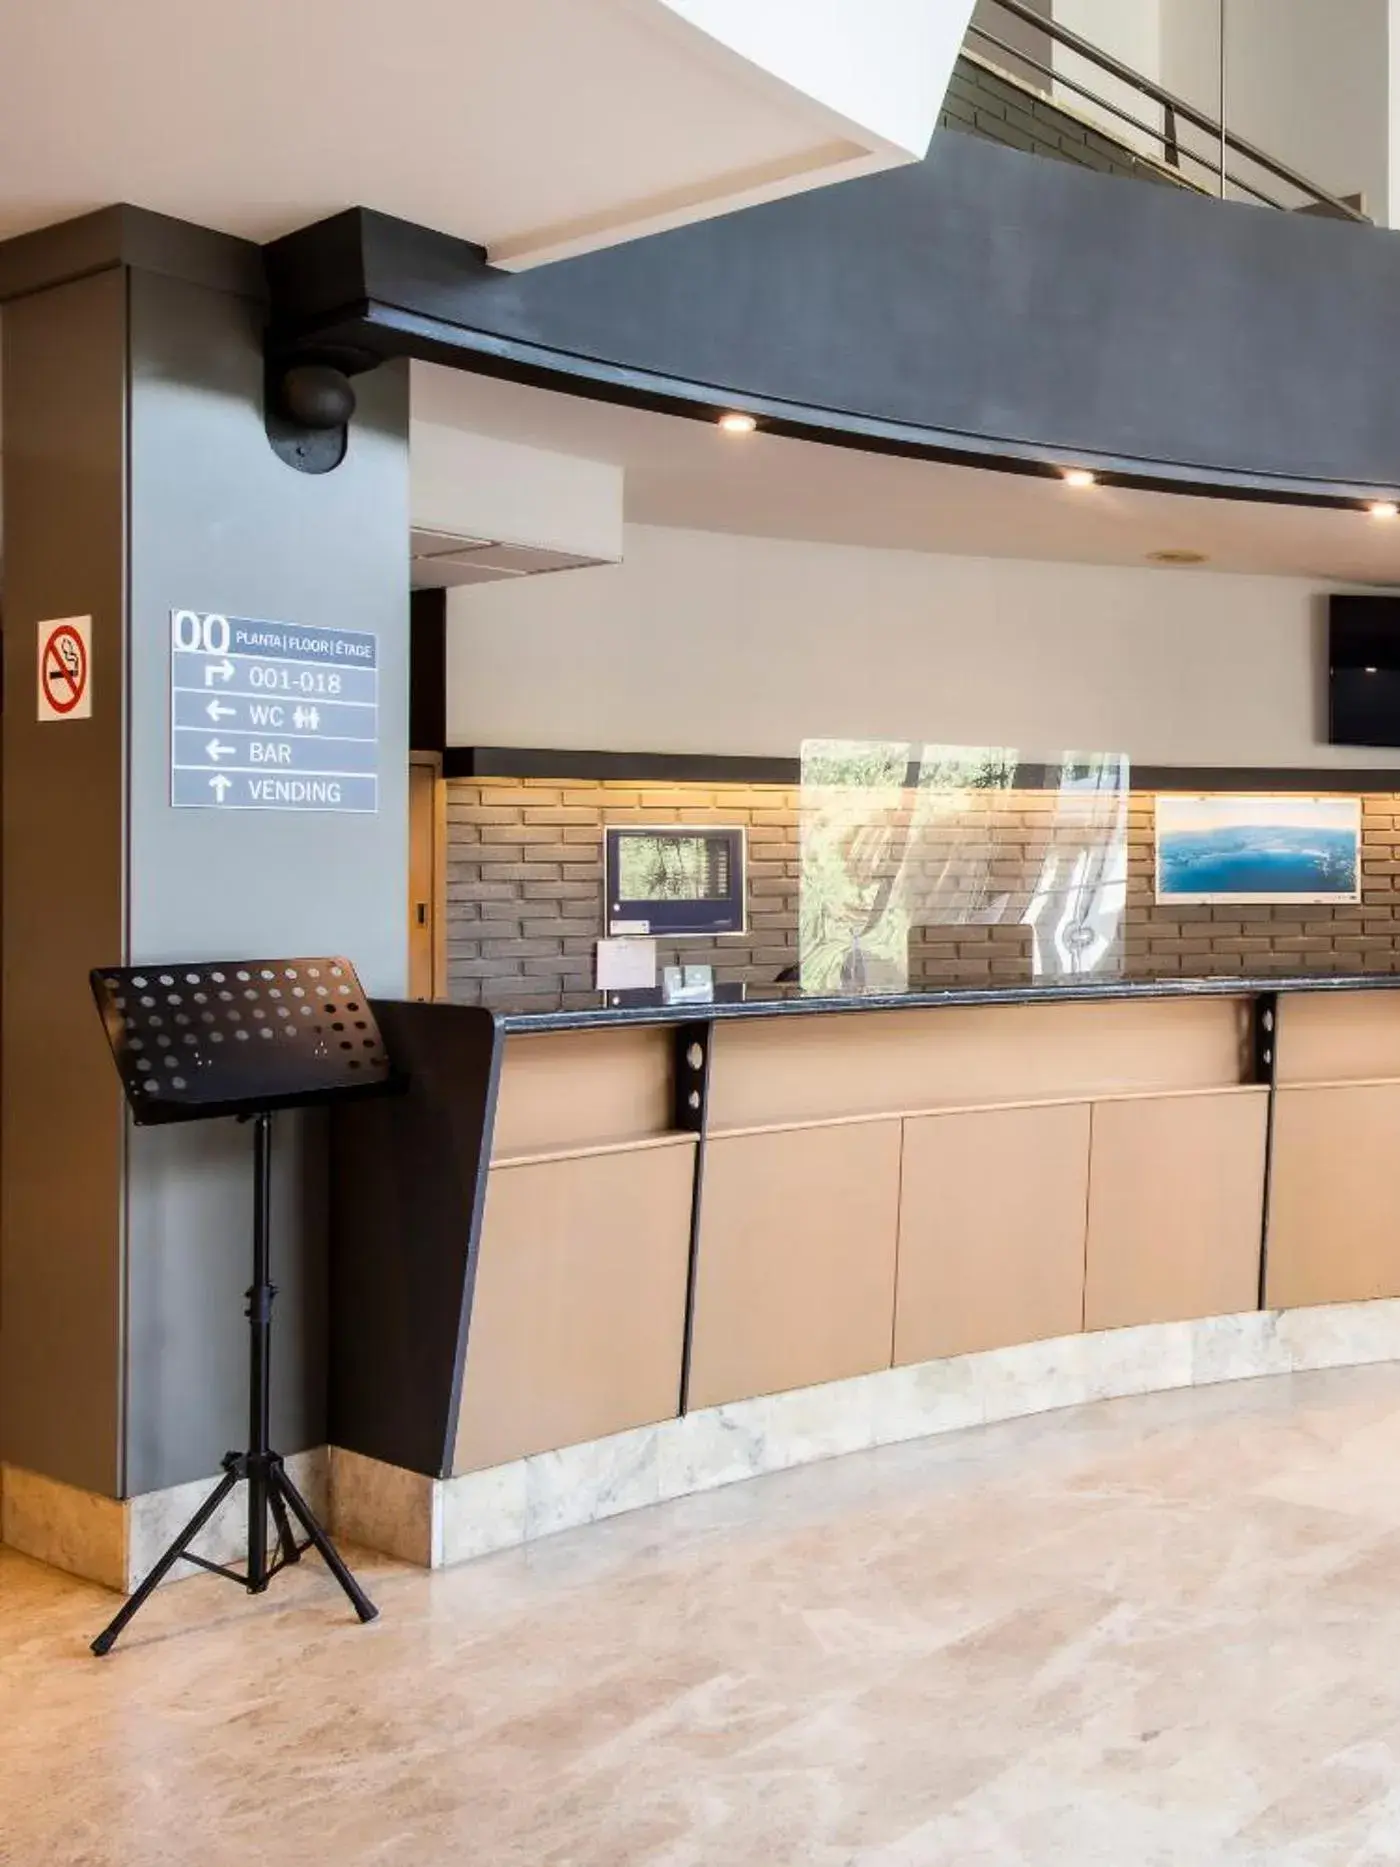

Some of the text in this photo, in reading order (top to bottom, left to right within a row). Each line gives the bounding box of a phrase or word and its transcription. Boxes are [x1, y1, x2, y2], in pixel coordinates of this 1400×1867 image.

[174, 610, 373, 659] 00 PLANTA FLOOR ÉTAGE
[249, 666, 342, 694] 001-018
[249, 703, 285, 728] WC
[249, 741, 292, 764] BAR
[247, 778, 342, 803] VENDING
